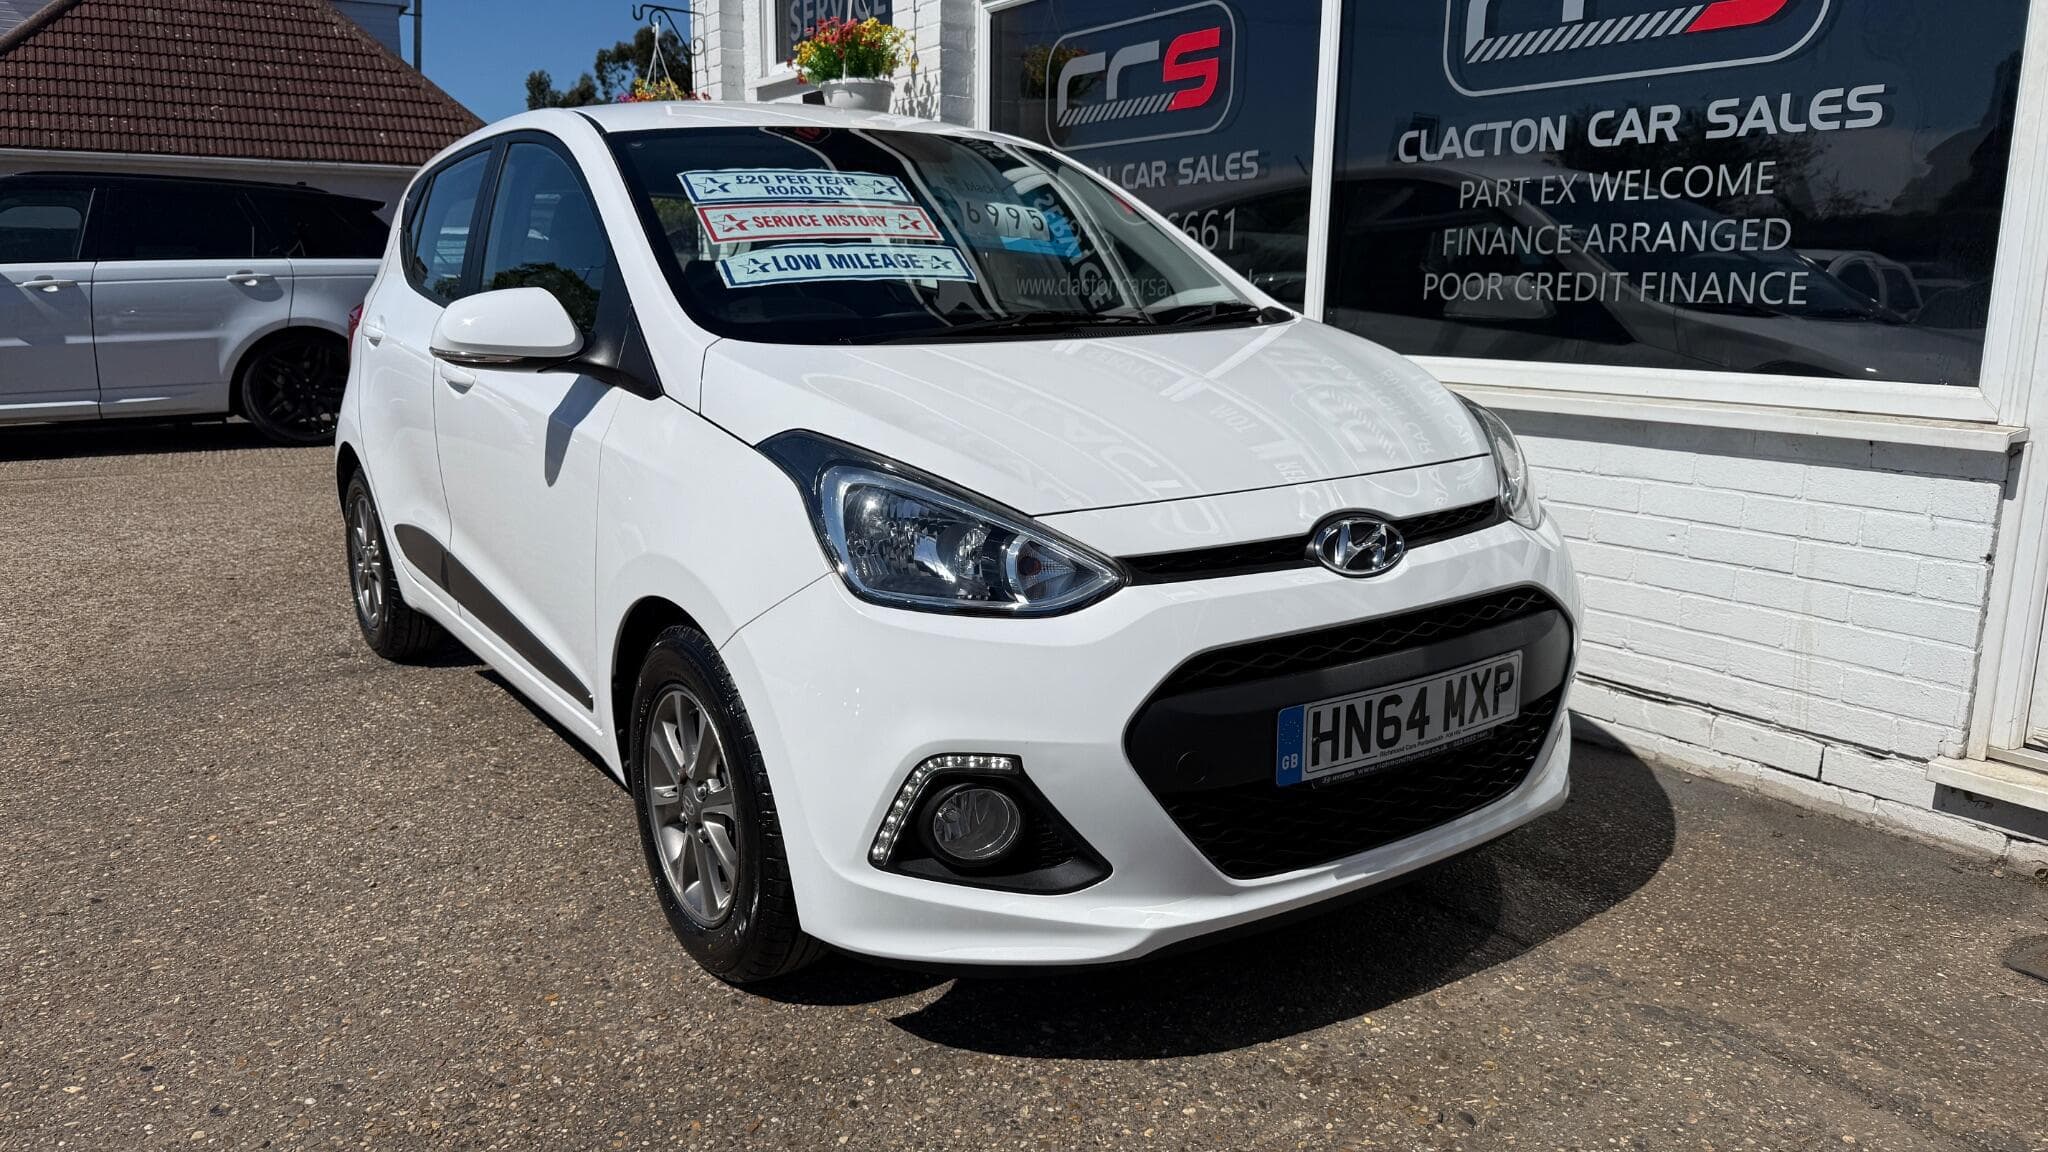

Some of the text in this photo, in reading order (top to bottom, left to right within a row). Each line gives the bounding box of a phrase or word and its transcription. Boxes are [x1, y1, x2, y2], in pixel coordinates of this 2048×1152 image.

[790, 0, 886, 40] SERVC
[1398, 84, 1886, 164] CLACTON CAR SALES
[736, 175, 858, 187] £20 PER YEAR
[1121, 160, 1167, 190] CAR
[1177, 150, 1260, 186] SALES
[1459, 161, 1776, 209] PART EX WELCOME
[765, 185, 849, 196] ROAD TAX
[751, 214, 889, 229] SERVICE HISTORY
[966, 201, 1044, 232] 6995
[1167, 208, 1235, 250] 661
[1443, 217, 1793, 257] FINANCE ARRANGED
[771, 252, 925, 273] LOW MILEAGE
[1423, 270, 1809, 306] POOR CREDIT FINANCE
[1311, 661, 1515, 767] HN64 MXP
[1281, 753, 1299, 771] GB
